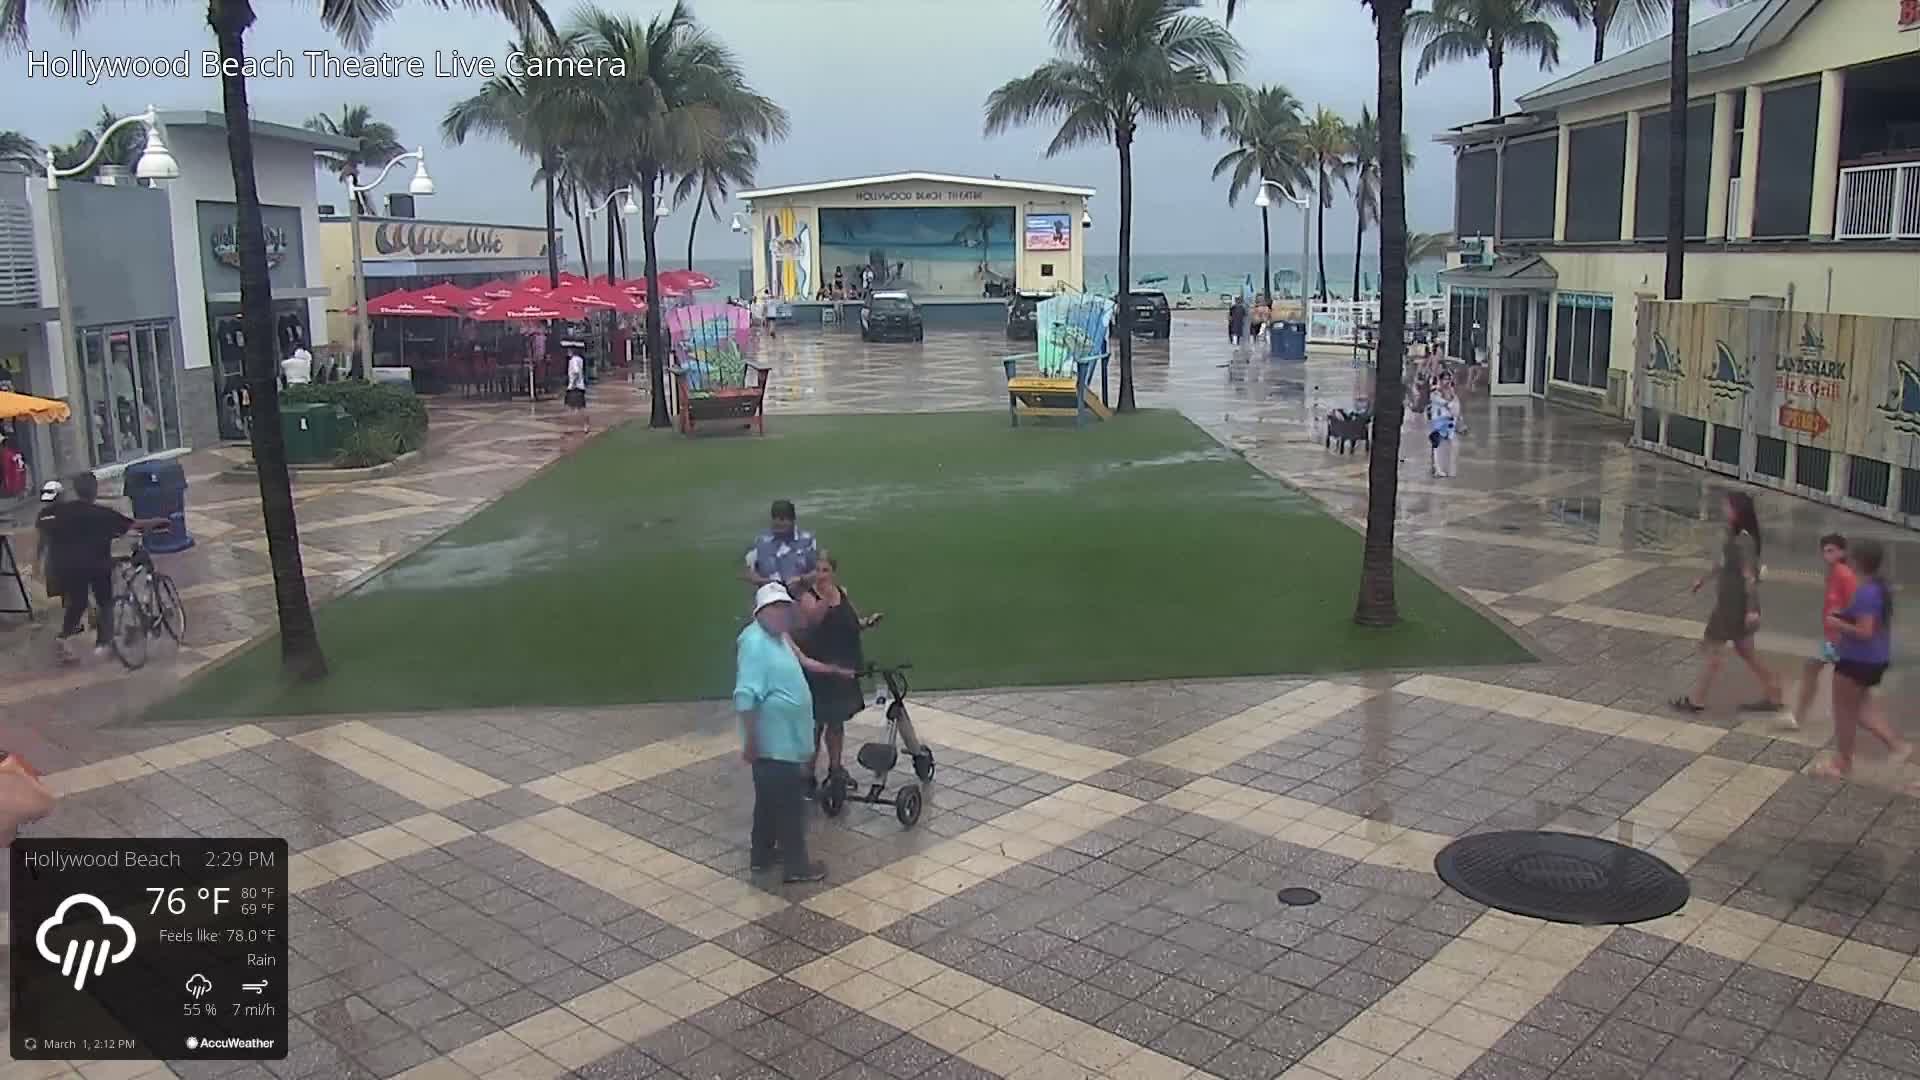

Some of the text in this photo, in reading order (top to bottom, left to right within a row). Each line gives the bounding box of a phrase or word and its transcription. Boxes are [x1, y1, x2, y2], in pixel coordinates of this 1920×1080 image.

[856, 191, 912, 201] HOLLYWOOD
[916, 191, 944, 201] BEACH
[1775, 354, 1846, 380] LANDSHARK
